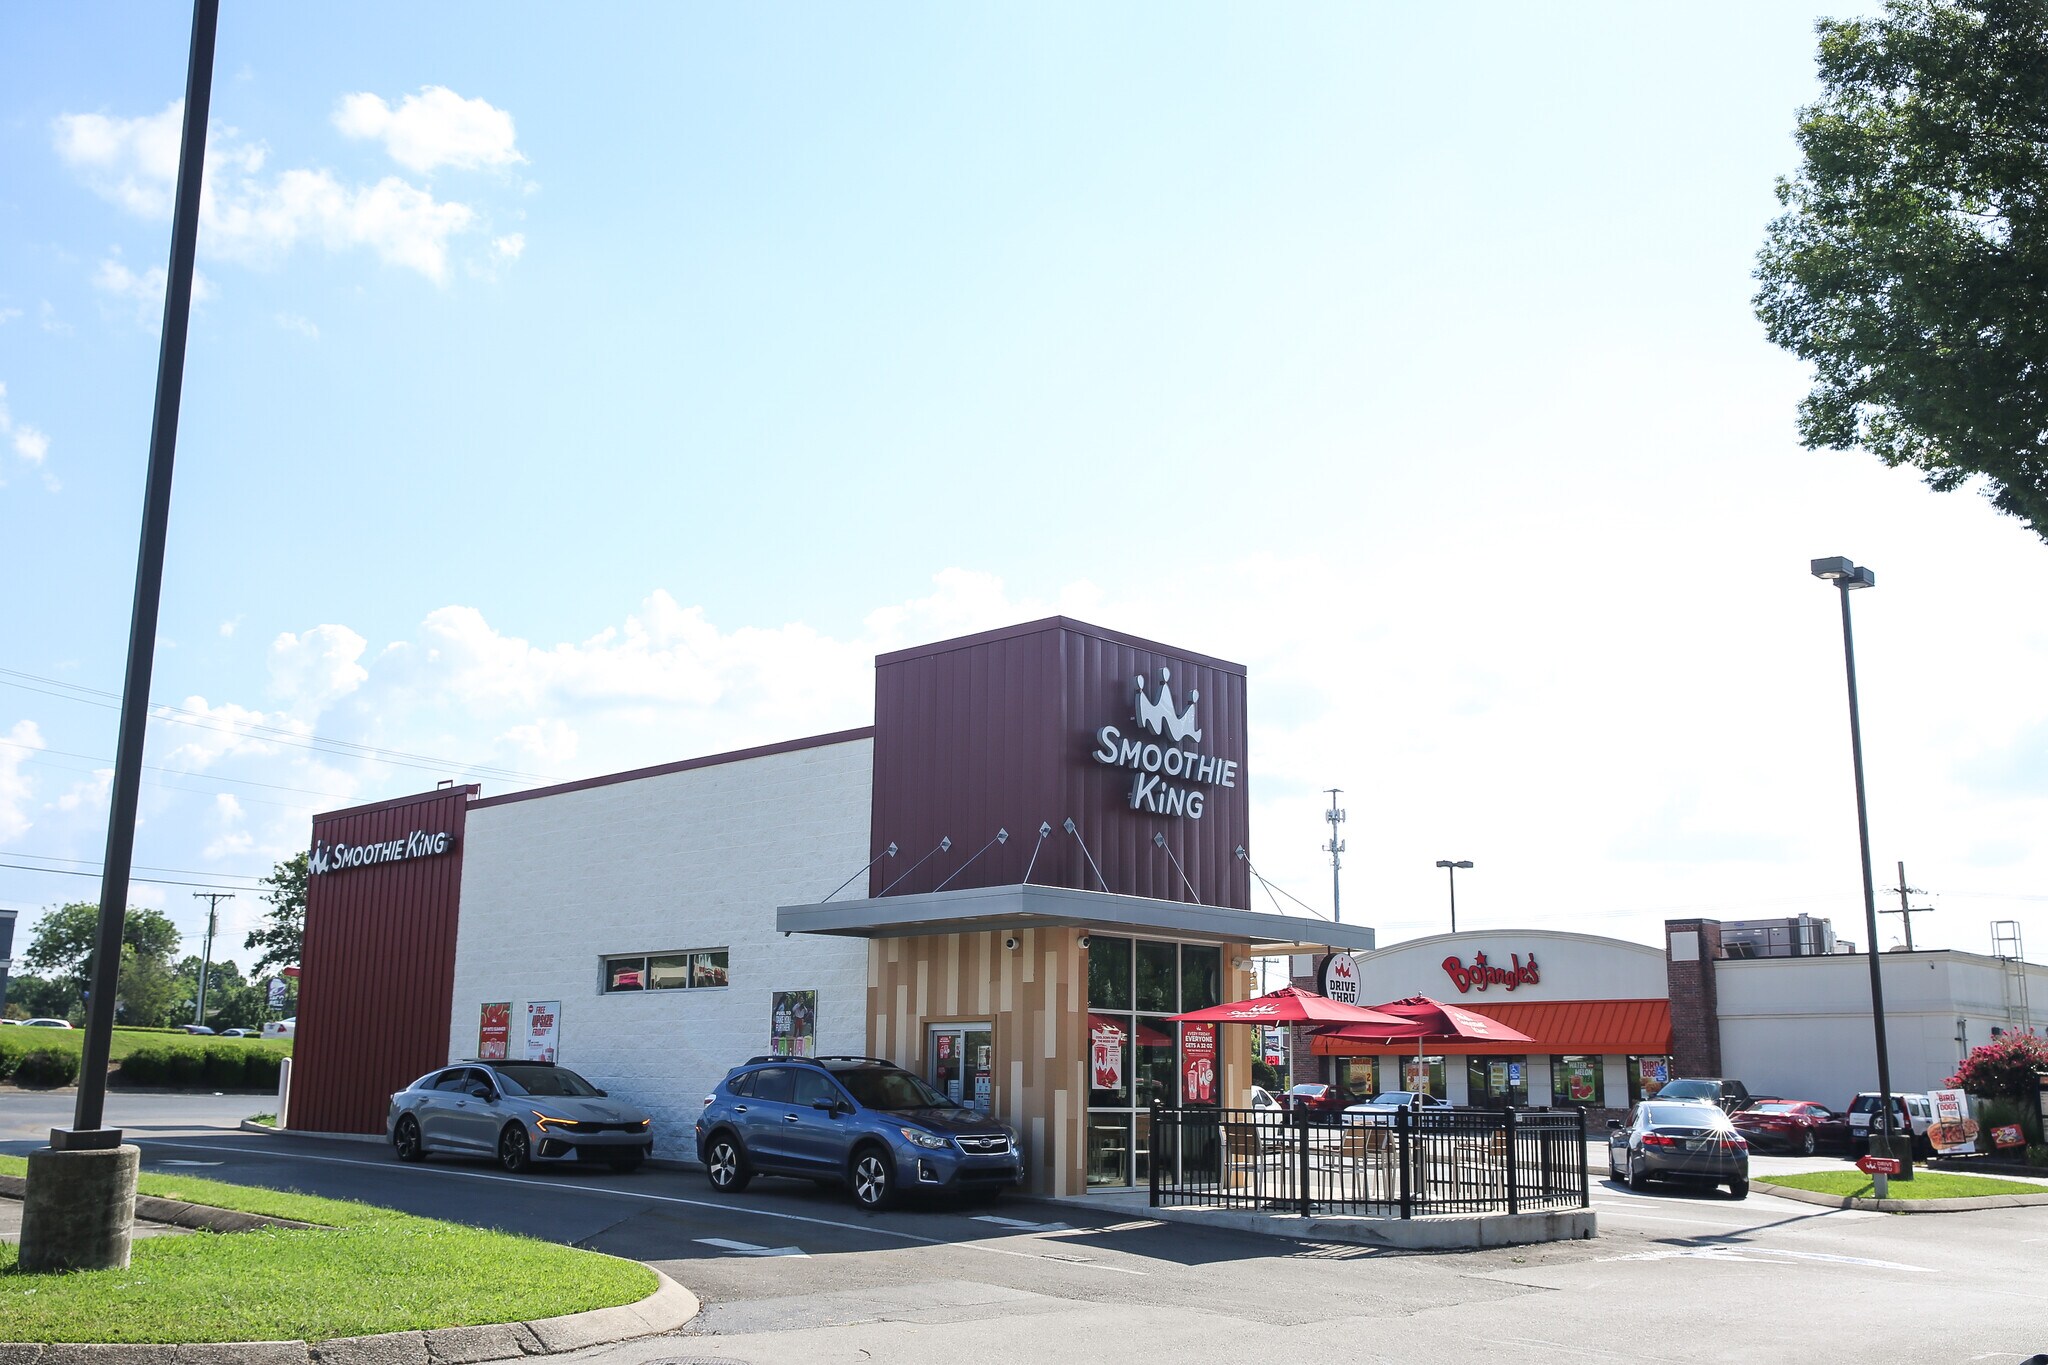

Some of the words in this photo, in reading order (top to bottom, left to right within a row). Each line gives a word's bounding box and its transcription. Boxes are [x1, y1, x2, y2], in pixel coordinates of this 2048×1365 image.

[1096, 725, 1238, 788] SMOOTHIE
[331, 839, 405, 870] SMOOTHIE
[1329, 979, 1356, 992] DRIVE
[1331, 991, 1356, 1003] THRU
[536, 1006, 546, 1014] FREE
[532, 1014, 554, 1027] UPSIZE
[532, 1028, 547, 1037] FRIDAY
[1642, 1060, 1659, 1070] BIRD
[1407, 1068, 1428, 1076] PEAH
[1642, 1069, 1656, 1077] DOG
[1366, 1073, 1371, 1081] 2
[1366, 1084, 1371, 1093] 4
[1938, 1094, 1956, 1102] BIRD
